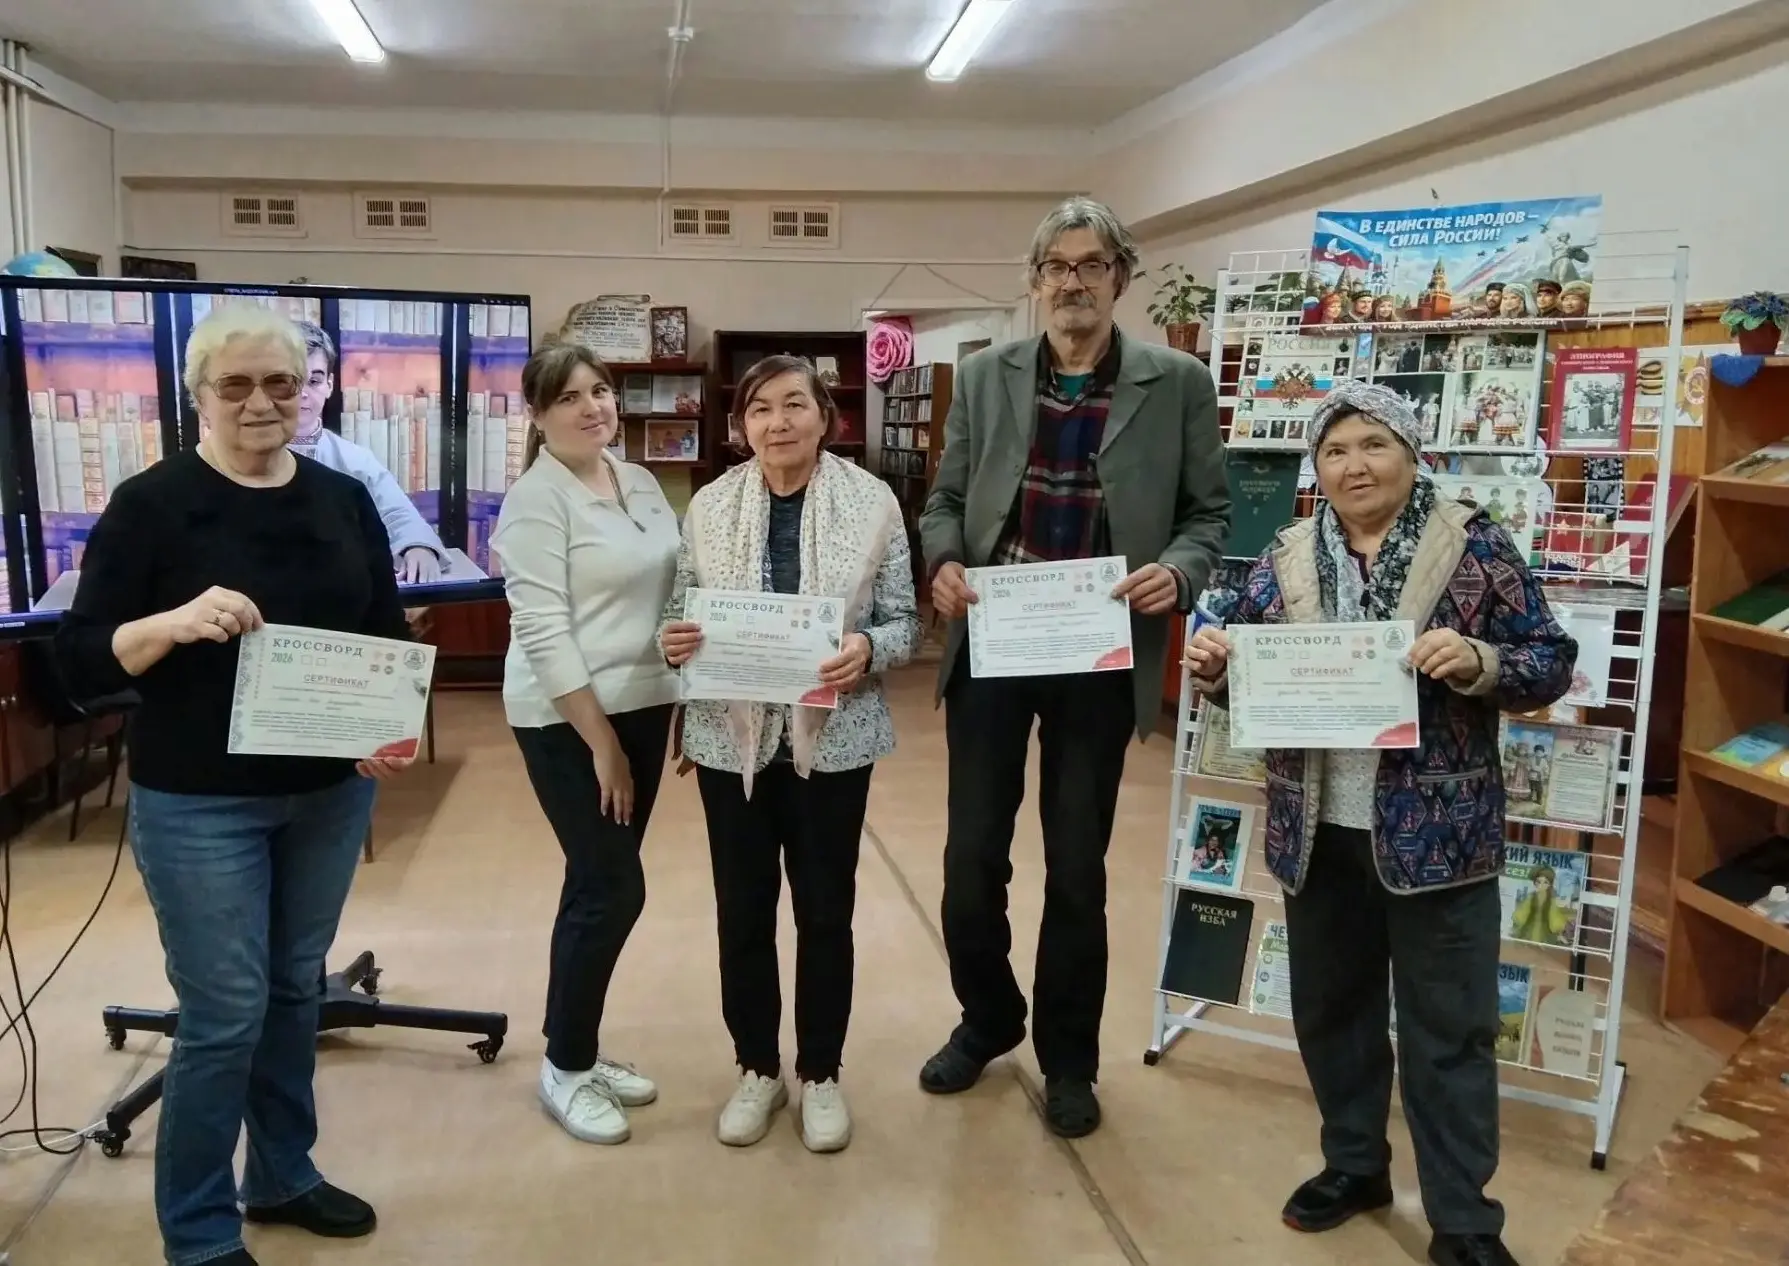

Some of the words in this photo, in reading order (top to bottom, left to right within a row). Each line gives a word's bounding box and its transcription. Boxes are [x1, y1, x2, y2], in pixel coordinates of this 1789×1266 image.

[1359, 218, 1372, 234] В
[1375, 215, 1452, 235] ЕДИНСТВЕ
[1455, 210, 1526, 229] НАРОДОВ
[1388, 231, 1429, 248] СИЛА
[1433, 228, 1502, 246] РОССИИ!
[991, 572, 1066, 587] КРОССВОРД
[710, 600, 784, 614] КРОССВОРД
[1021, 600, 1077, 611] СЕРТИФИКАТ
[736, 630, 791, 641] СЕРТИФИКАТ
[1255, 635, 1342, 646] КРОССВОРД
[272, 638, 363, 657] КРОССВОРД
[1290, 666, 1355, 677] СЕРТИФИКАТ
[303, 674, 370, 688] СЕРТИФИКАТ
[1533, 850, 1575, 870] ЯЗЫК
[1191, 903, 1237, 919] РУССКАЯ
[1200, 914, 1226, 927] ИЗБА
[1270, 924, 1287, 938] ЧЕ
[1499, 963, 1530, 983] ЗЫК
